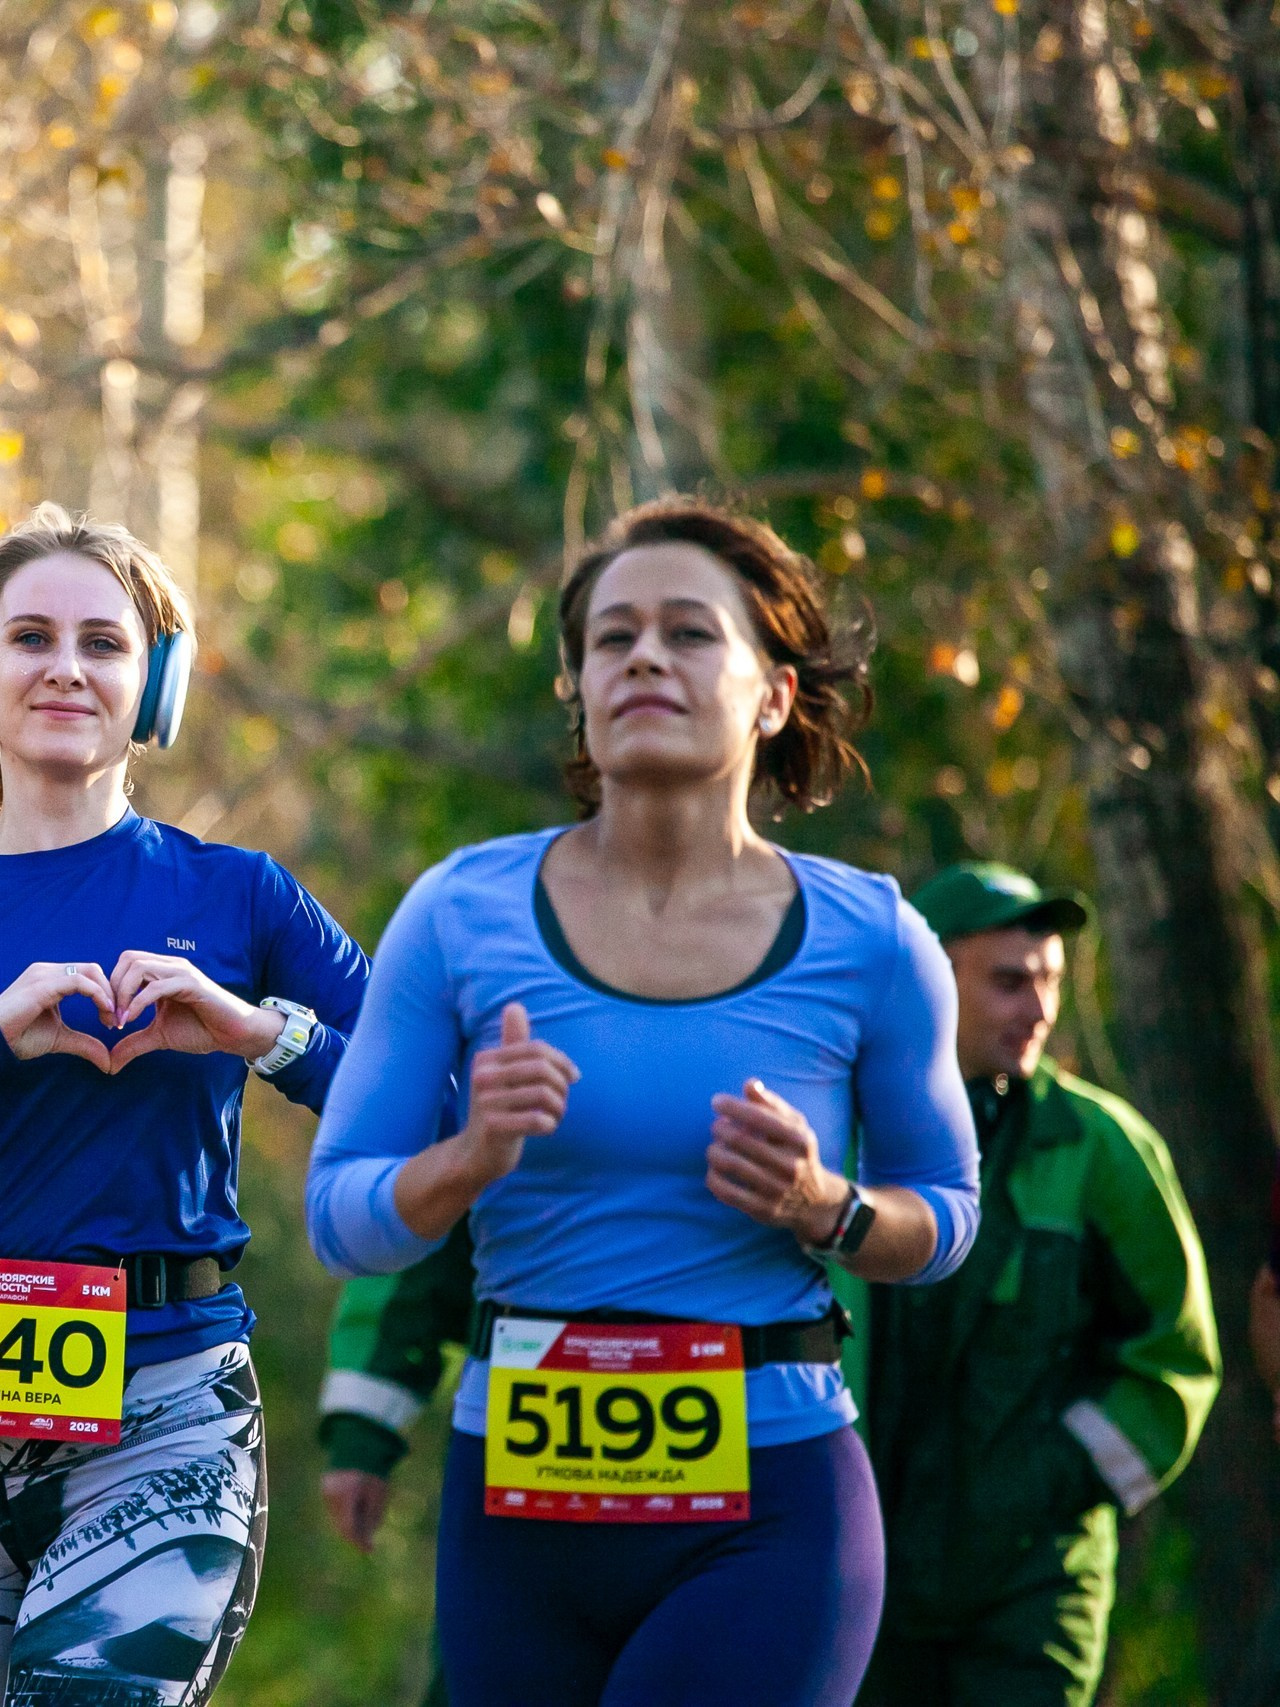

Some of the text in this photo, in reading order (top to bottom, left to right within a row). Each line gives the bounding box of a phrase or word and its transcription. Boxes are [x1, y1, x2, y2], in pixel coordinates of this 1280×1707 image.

[166, 937, 196, 951] RUN
[82, 1285, 111, 1297] 5 КМ
[25, 1391, 62, 1405] ВЕРА
[69, 1421, 99, 1433] 2026
[505, 1382, 721, 1462] 5199
[598, 1467, 685, 1483] НАДЕЖДА
